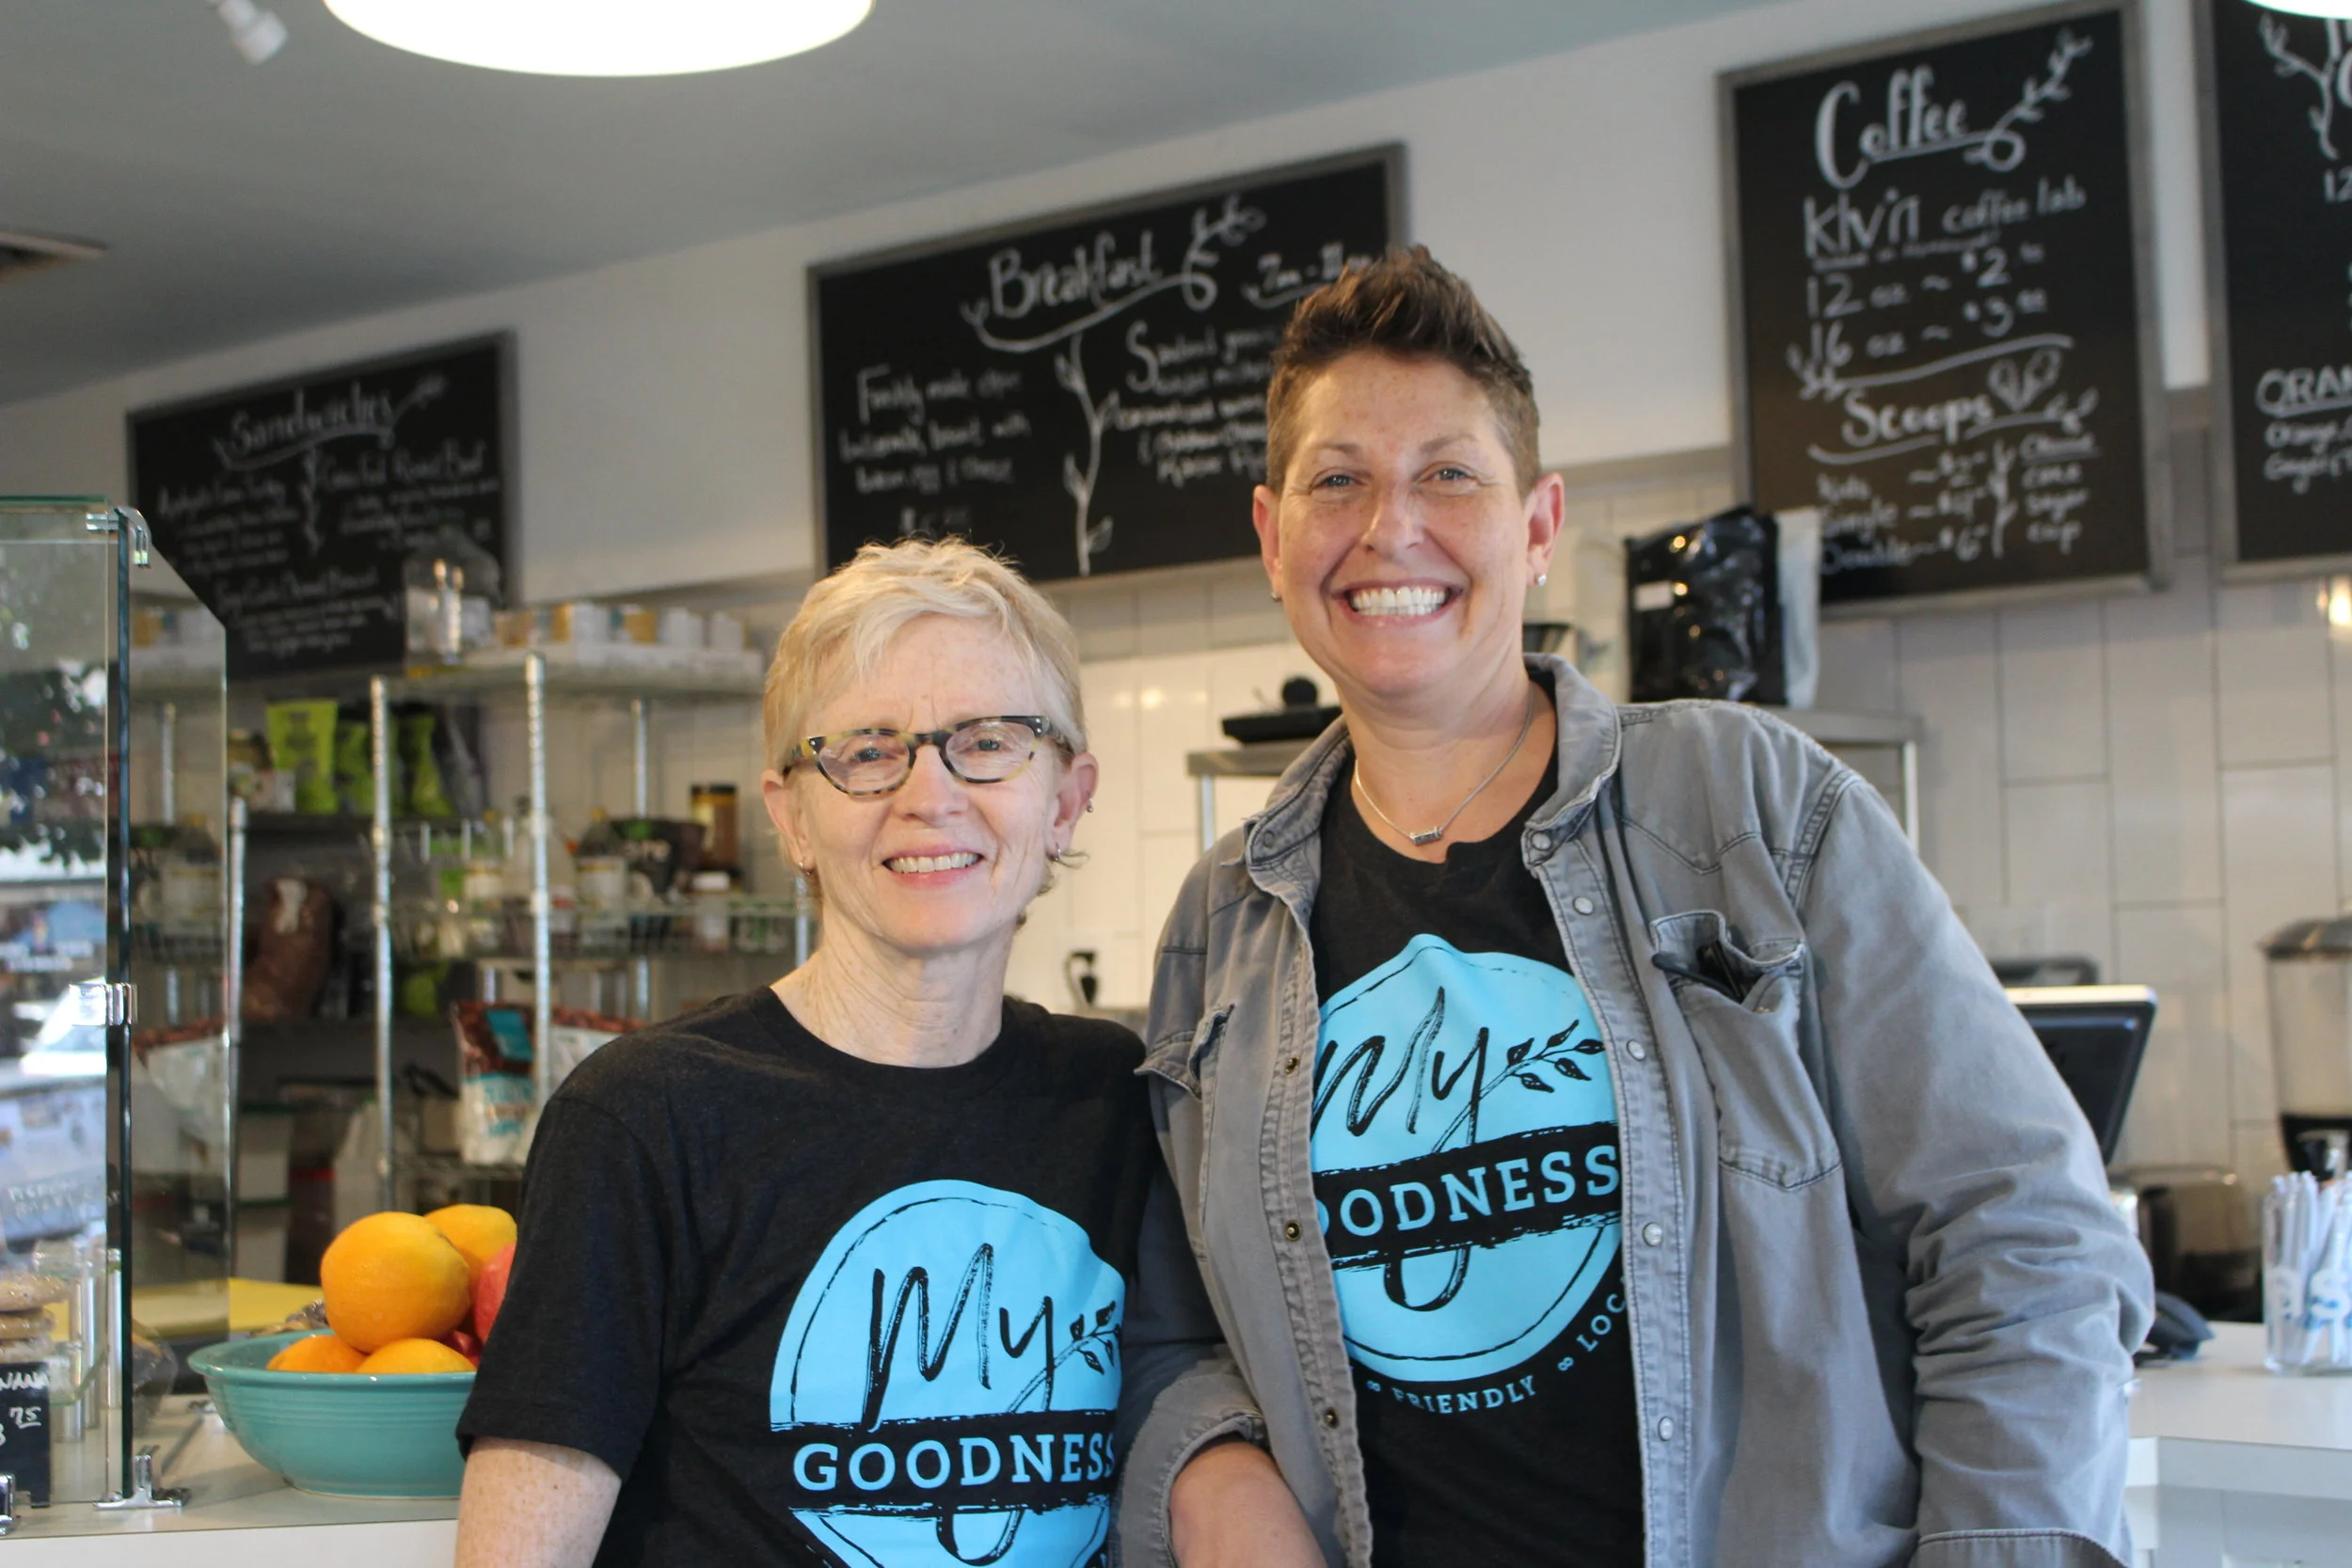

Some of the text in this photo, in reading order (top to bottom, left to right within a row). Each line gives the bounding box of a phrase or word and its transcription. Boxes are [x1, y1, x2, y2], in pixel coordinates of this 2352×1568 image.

[1816, 64, 1969, 187] Coffee
[2038, 174, 2086, 214] lab
[988, 230, 1163, 320] Breakfast
[1807, 273, 1865, 320] 12
[1811, 320, 1852, 368] 16
[1841, 389, 1994, 446] Scoops
[1311, 986, 1489, 1166] My
[862, 1243, 1055, 1439] My
[1577, 1281, 1626, 1352] LOC
[1393, 1375, 1536, 1414] FRIENDLY
